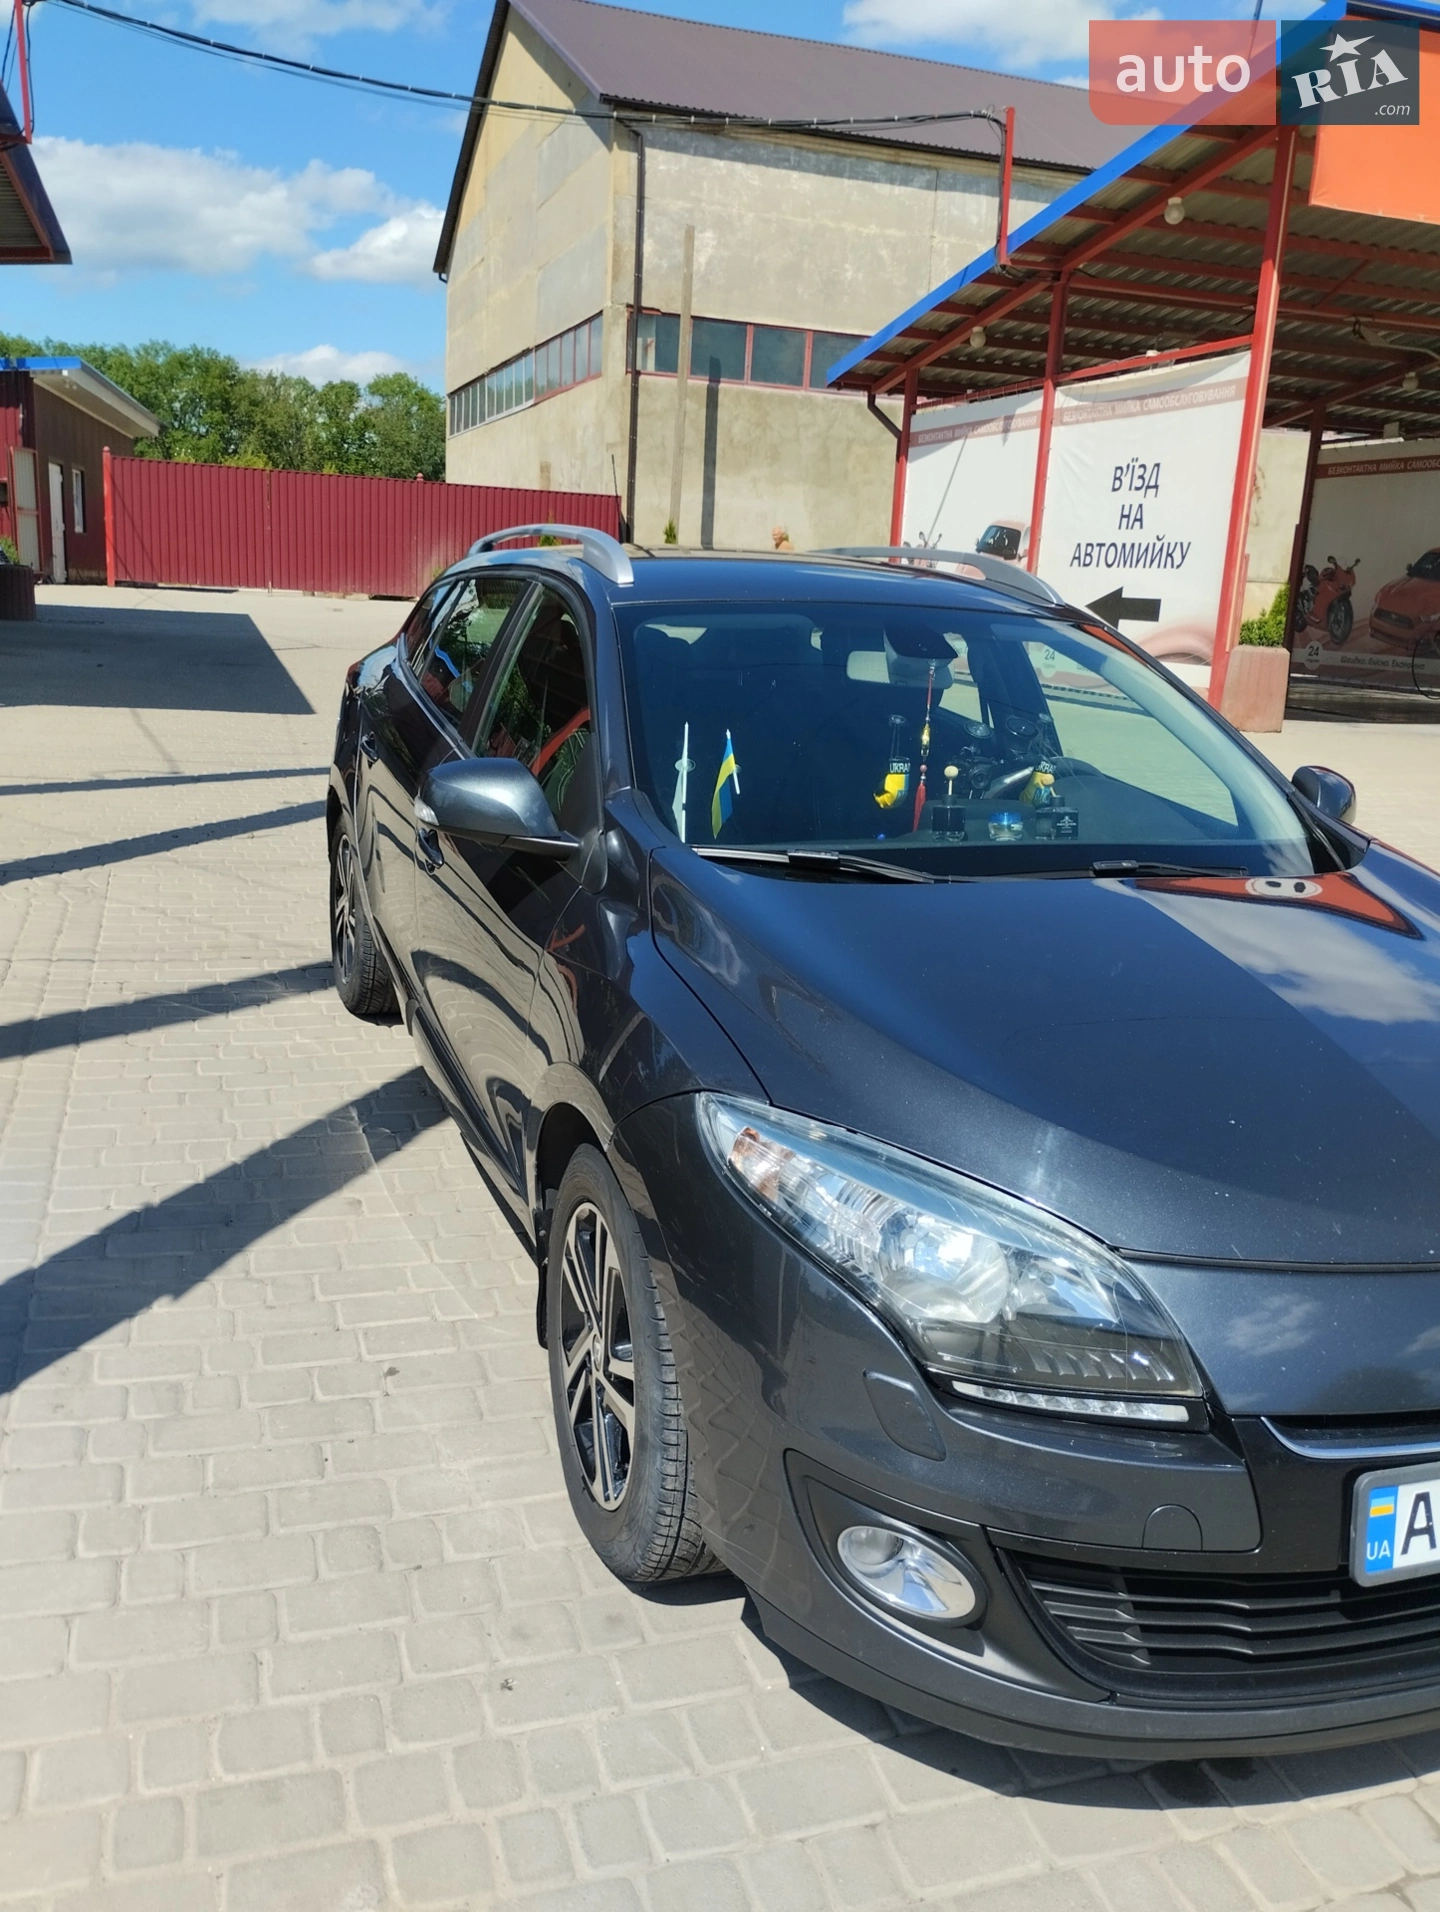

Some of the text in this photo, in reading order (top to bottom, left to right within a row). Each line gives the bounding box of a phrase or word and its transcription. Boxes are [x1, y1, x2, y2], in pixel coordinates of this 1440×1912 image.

[1114, 399, 1141, 415] МИЙКА
[1142, 384, 1237, 411] САМООБСЛУГОВУВАННЯ
[1111, 457, 1161, 498] В'ЇЗД
[1327, 463, 1377, 476] БЕЗКОНТАКТНА
[1378, 460, 1405, 472] МИЙКА
[1118, 503, 1144, 530] НА
[1069, 534, 1191, 570] АВТОМИЙКУ
[1044, 649, 1056, 661] 24
[1308, 646, 1320, 656] 24
[1366, 1490, 1437, 1560] UA A
